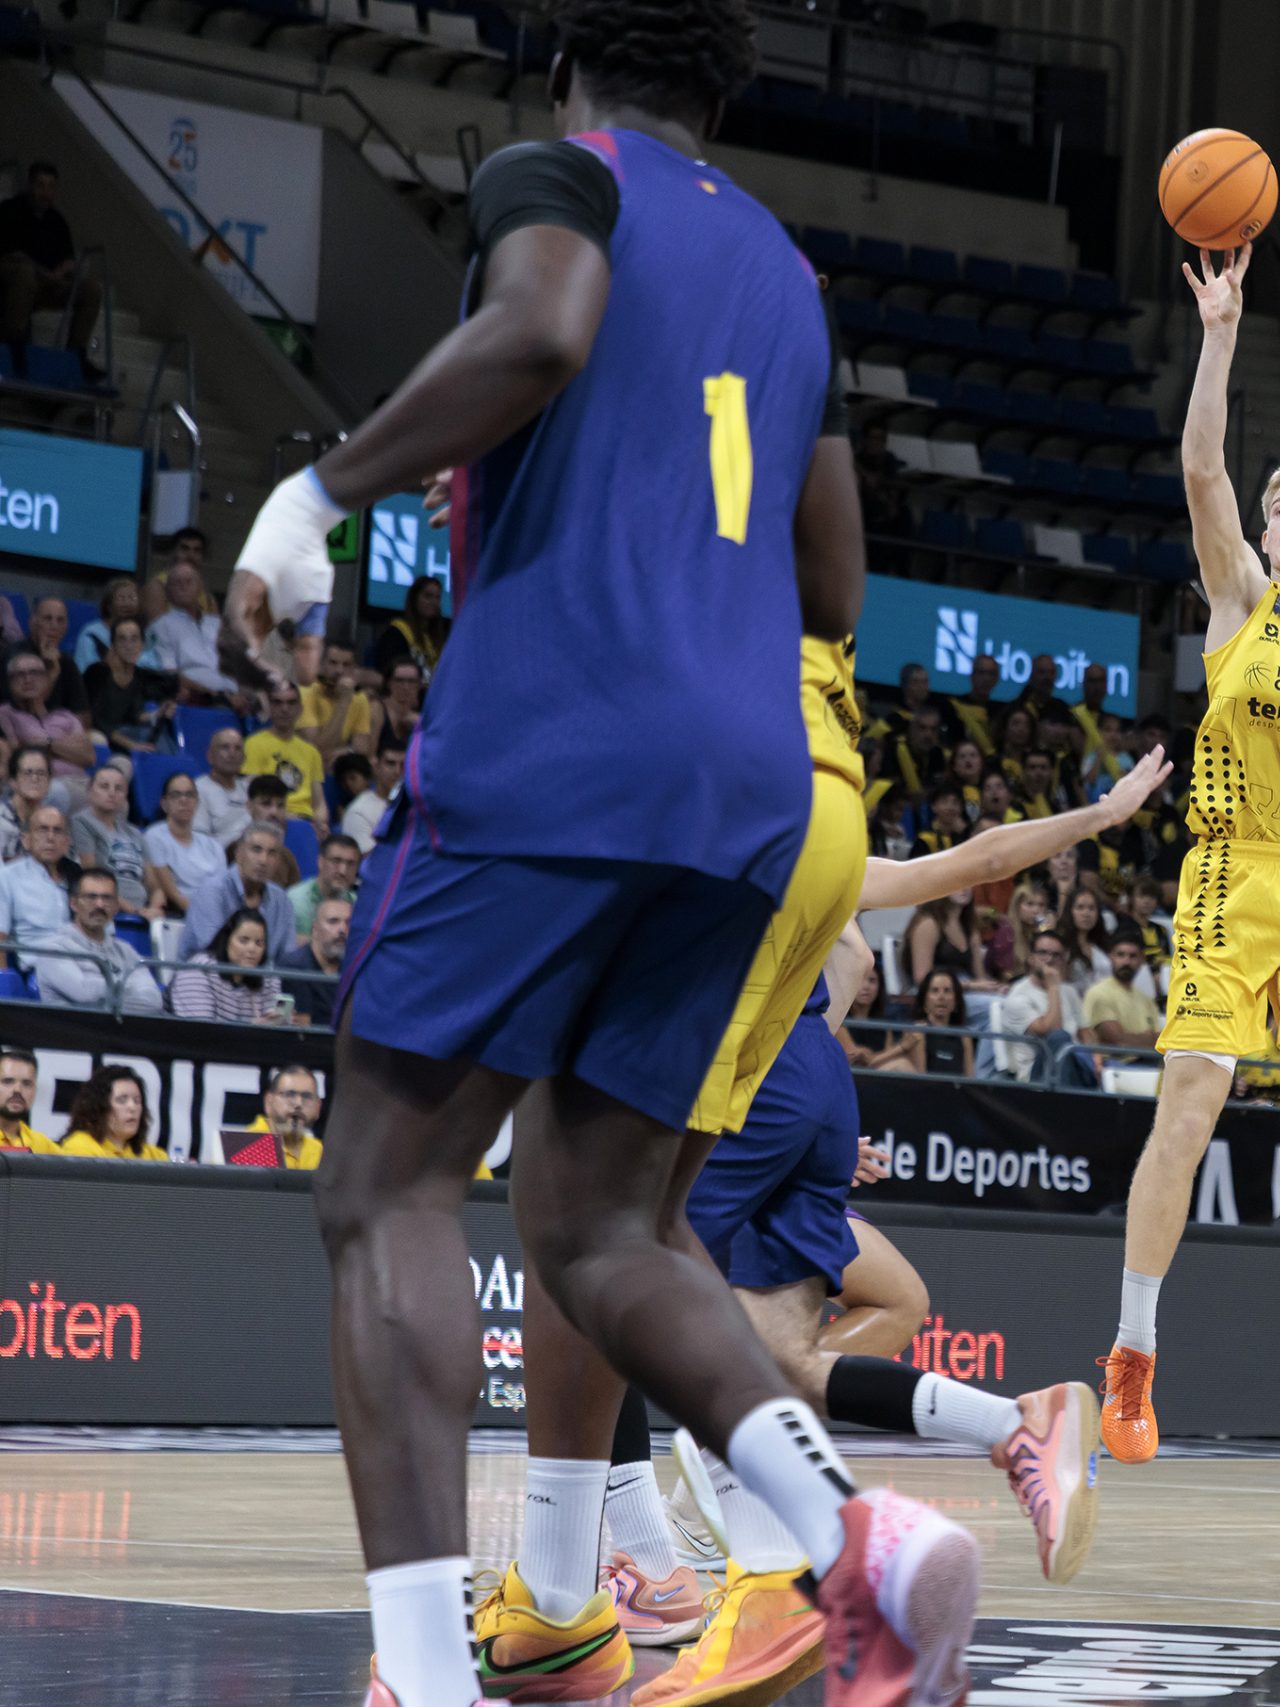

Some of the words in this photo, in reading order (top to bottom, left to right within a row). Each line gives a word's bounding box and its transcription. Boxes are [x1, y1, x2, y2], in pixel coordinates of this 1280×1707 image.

[703, 370, 753, 546] 1
[925, 1131, 1092, 1198] Deportes
[911, 1315, 1006, 1381] iten
